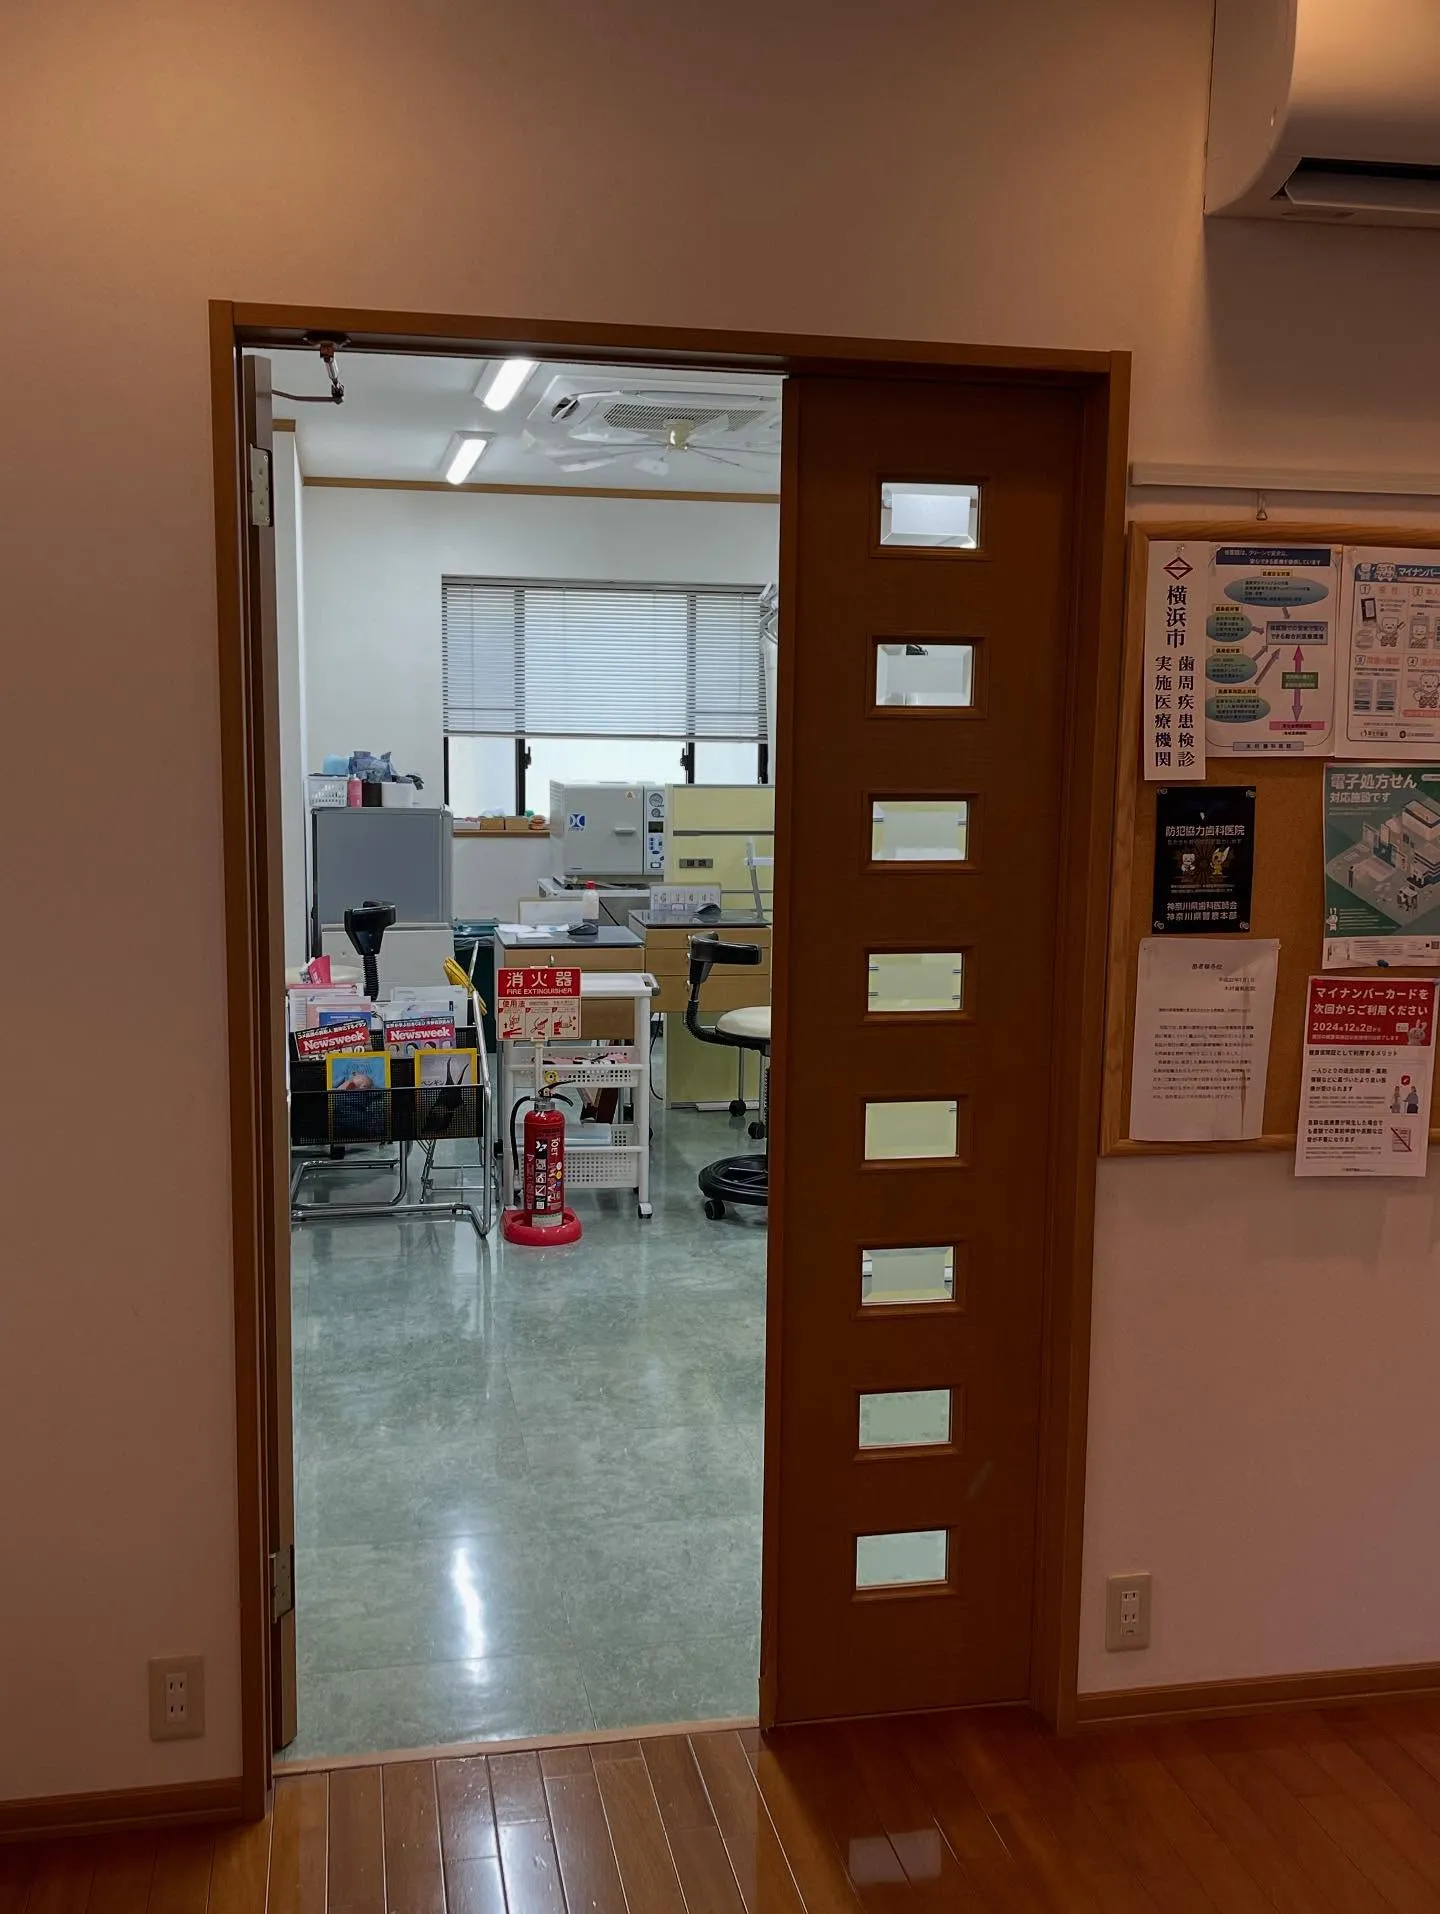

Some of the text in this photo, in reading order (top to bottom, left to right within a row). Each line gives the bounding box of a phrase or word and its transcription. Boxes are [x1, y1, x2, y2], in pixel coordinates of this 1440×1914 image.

[1166, 585, 1187, 649] 横浜市
[1154, 655, 1172, 767] 実施医療機関
[1177, 656, 1195, 767] 歯周疾患検診
[1331, 773, 1417, 790] 電子処方せん
[1329, 792, 1391, 803] 対応施設です
[1165, 825, 1245, 837] 防犯協力歯科医院
[1166, 900, 1238, 910] 神奈川県歯科医師会
[1166, 911, 1238, 921] 神奈川県警察本部
[506, 971, 573, 988] 消火器
[523, 987, 573, 995] EXTINGUISHER
[1316, 987, 1429, 1000] マイナンバーカードを
[503, 1000, 526, 1008] 使用法
[1313, 1003, 1428, 1016] 次回からご利用ください
[390, 1027, 451, 1041] Newsweek
[303, 1031, 365, 1051] Newsweek
